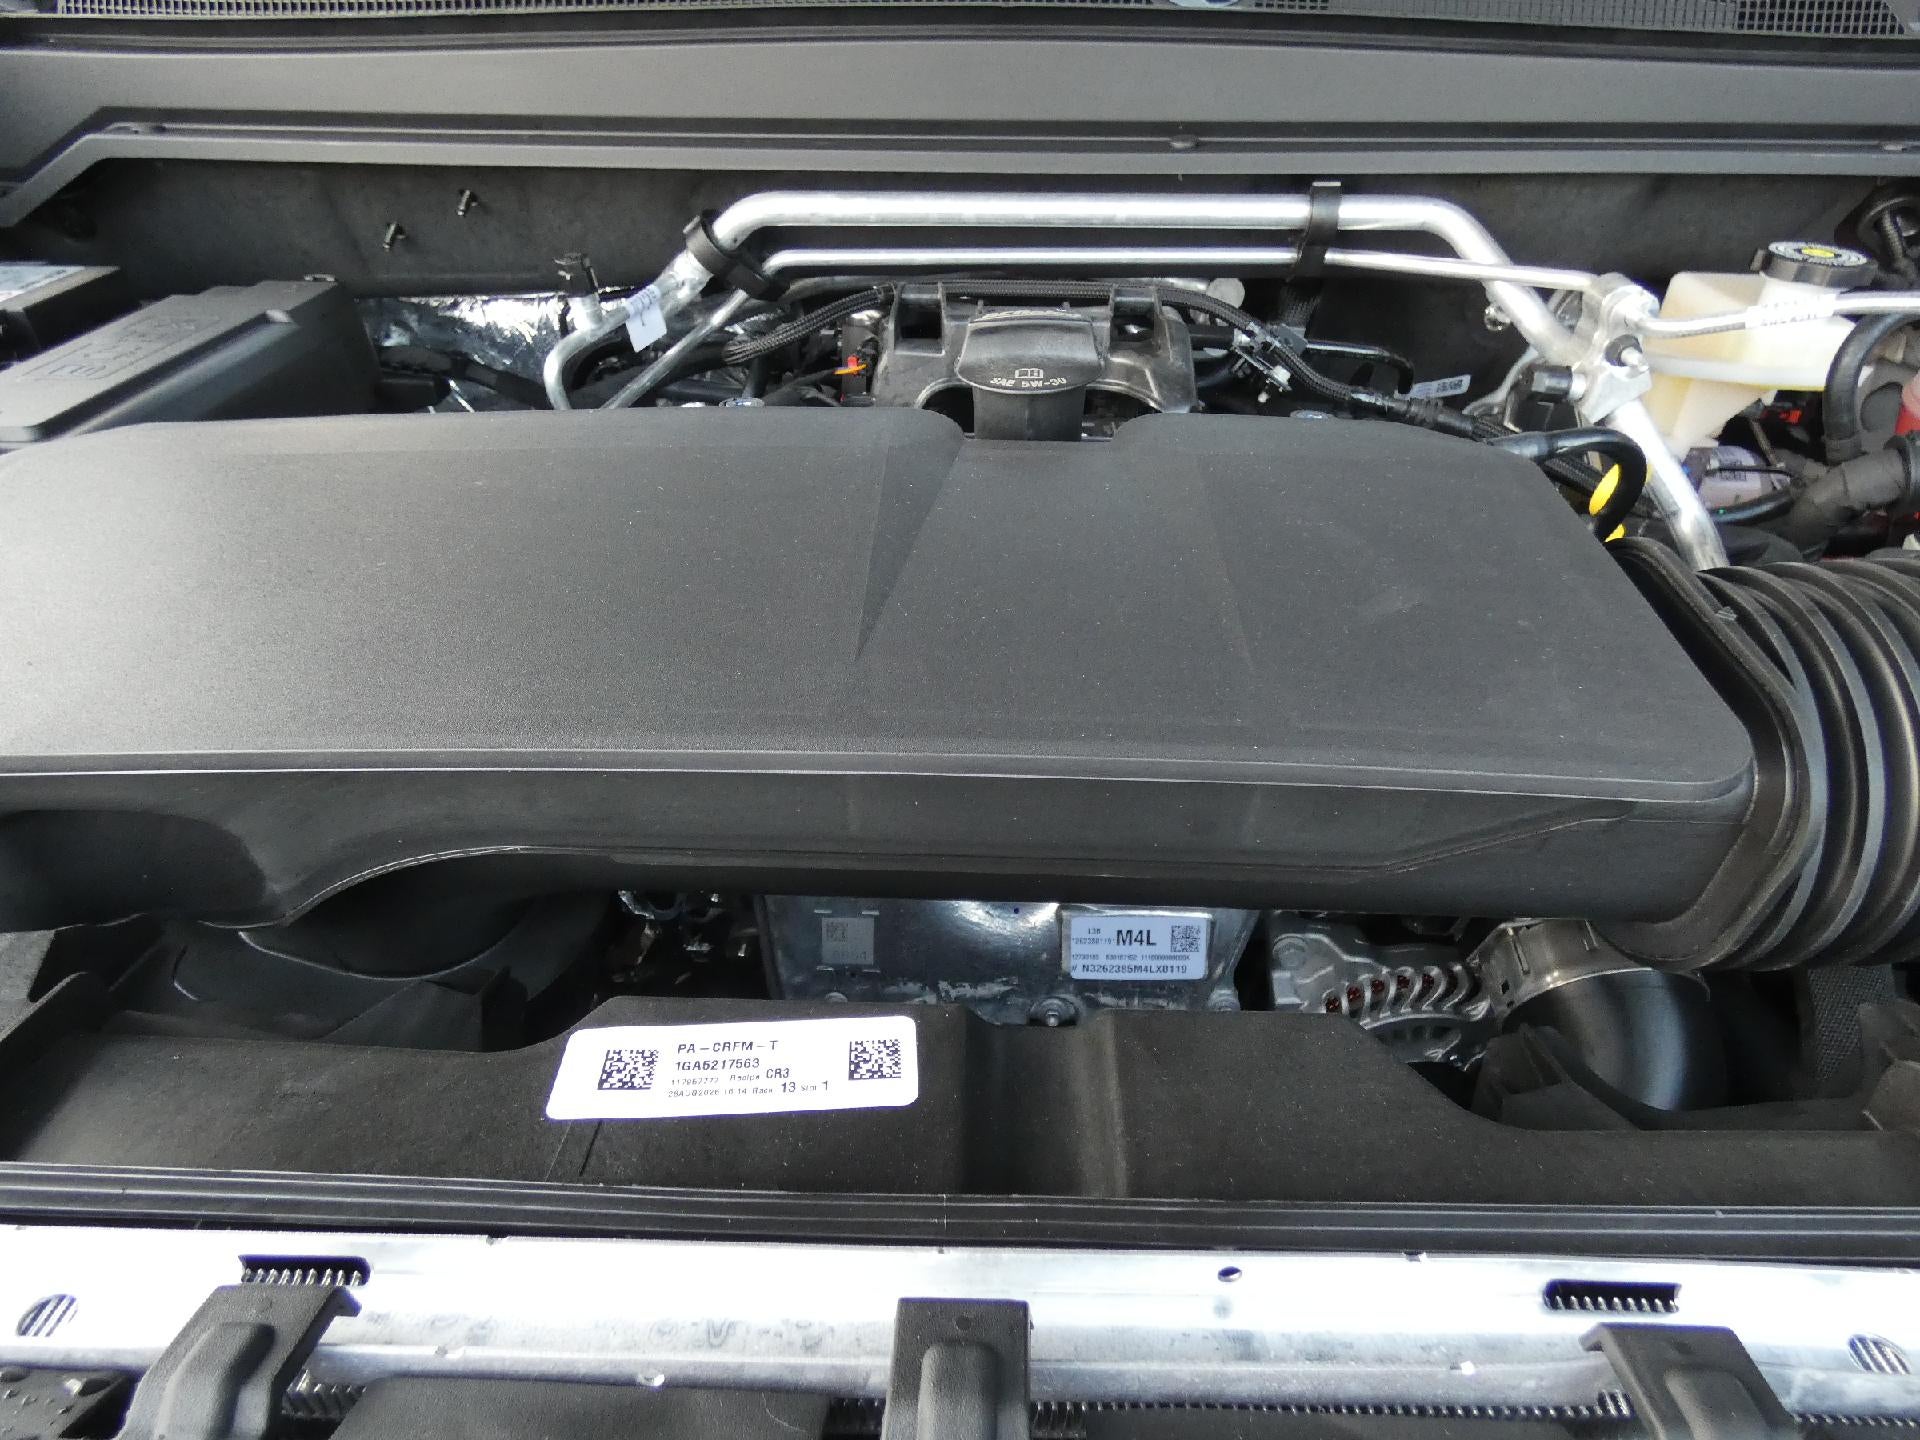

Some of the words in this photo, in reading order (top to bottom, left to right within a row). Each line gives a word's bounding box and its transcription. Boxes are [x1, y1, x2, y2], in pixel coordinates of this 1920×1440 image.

[1116, 929, 1157, 946] M4L
[766, 1067, 790, 1079] CR3
[781, 1081, 796, 1094] 13
[821, 1079, 828, 1092] 1
